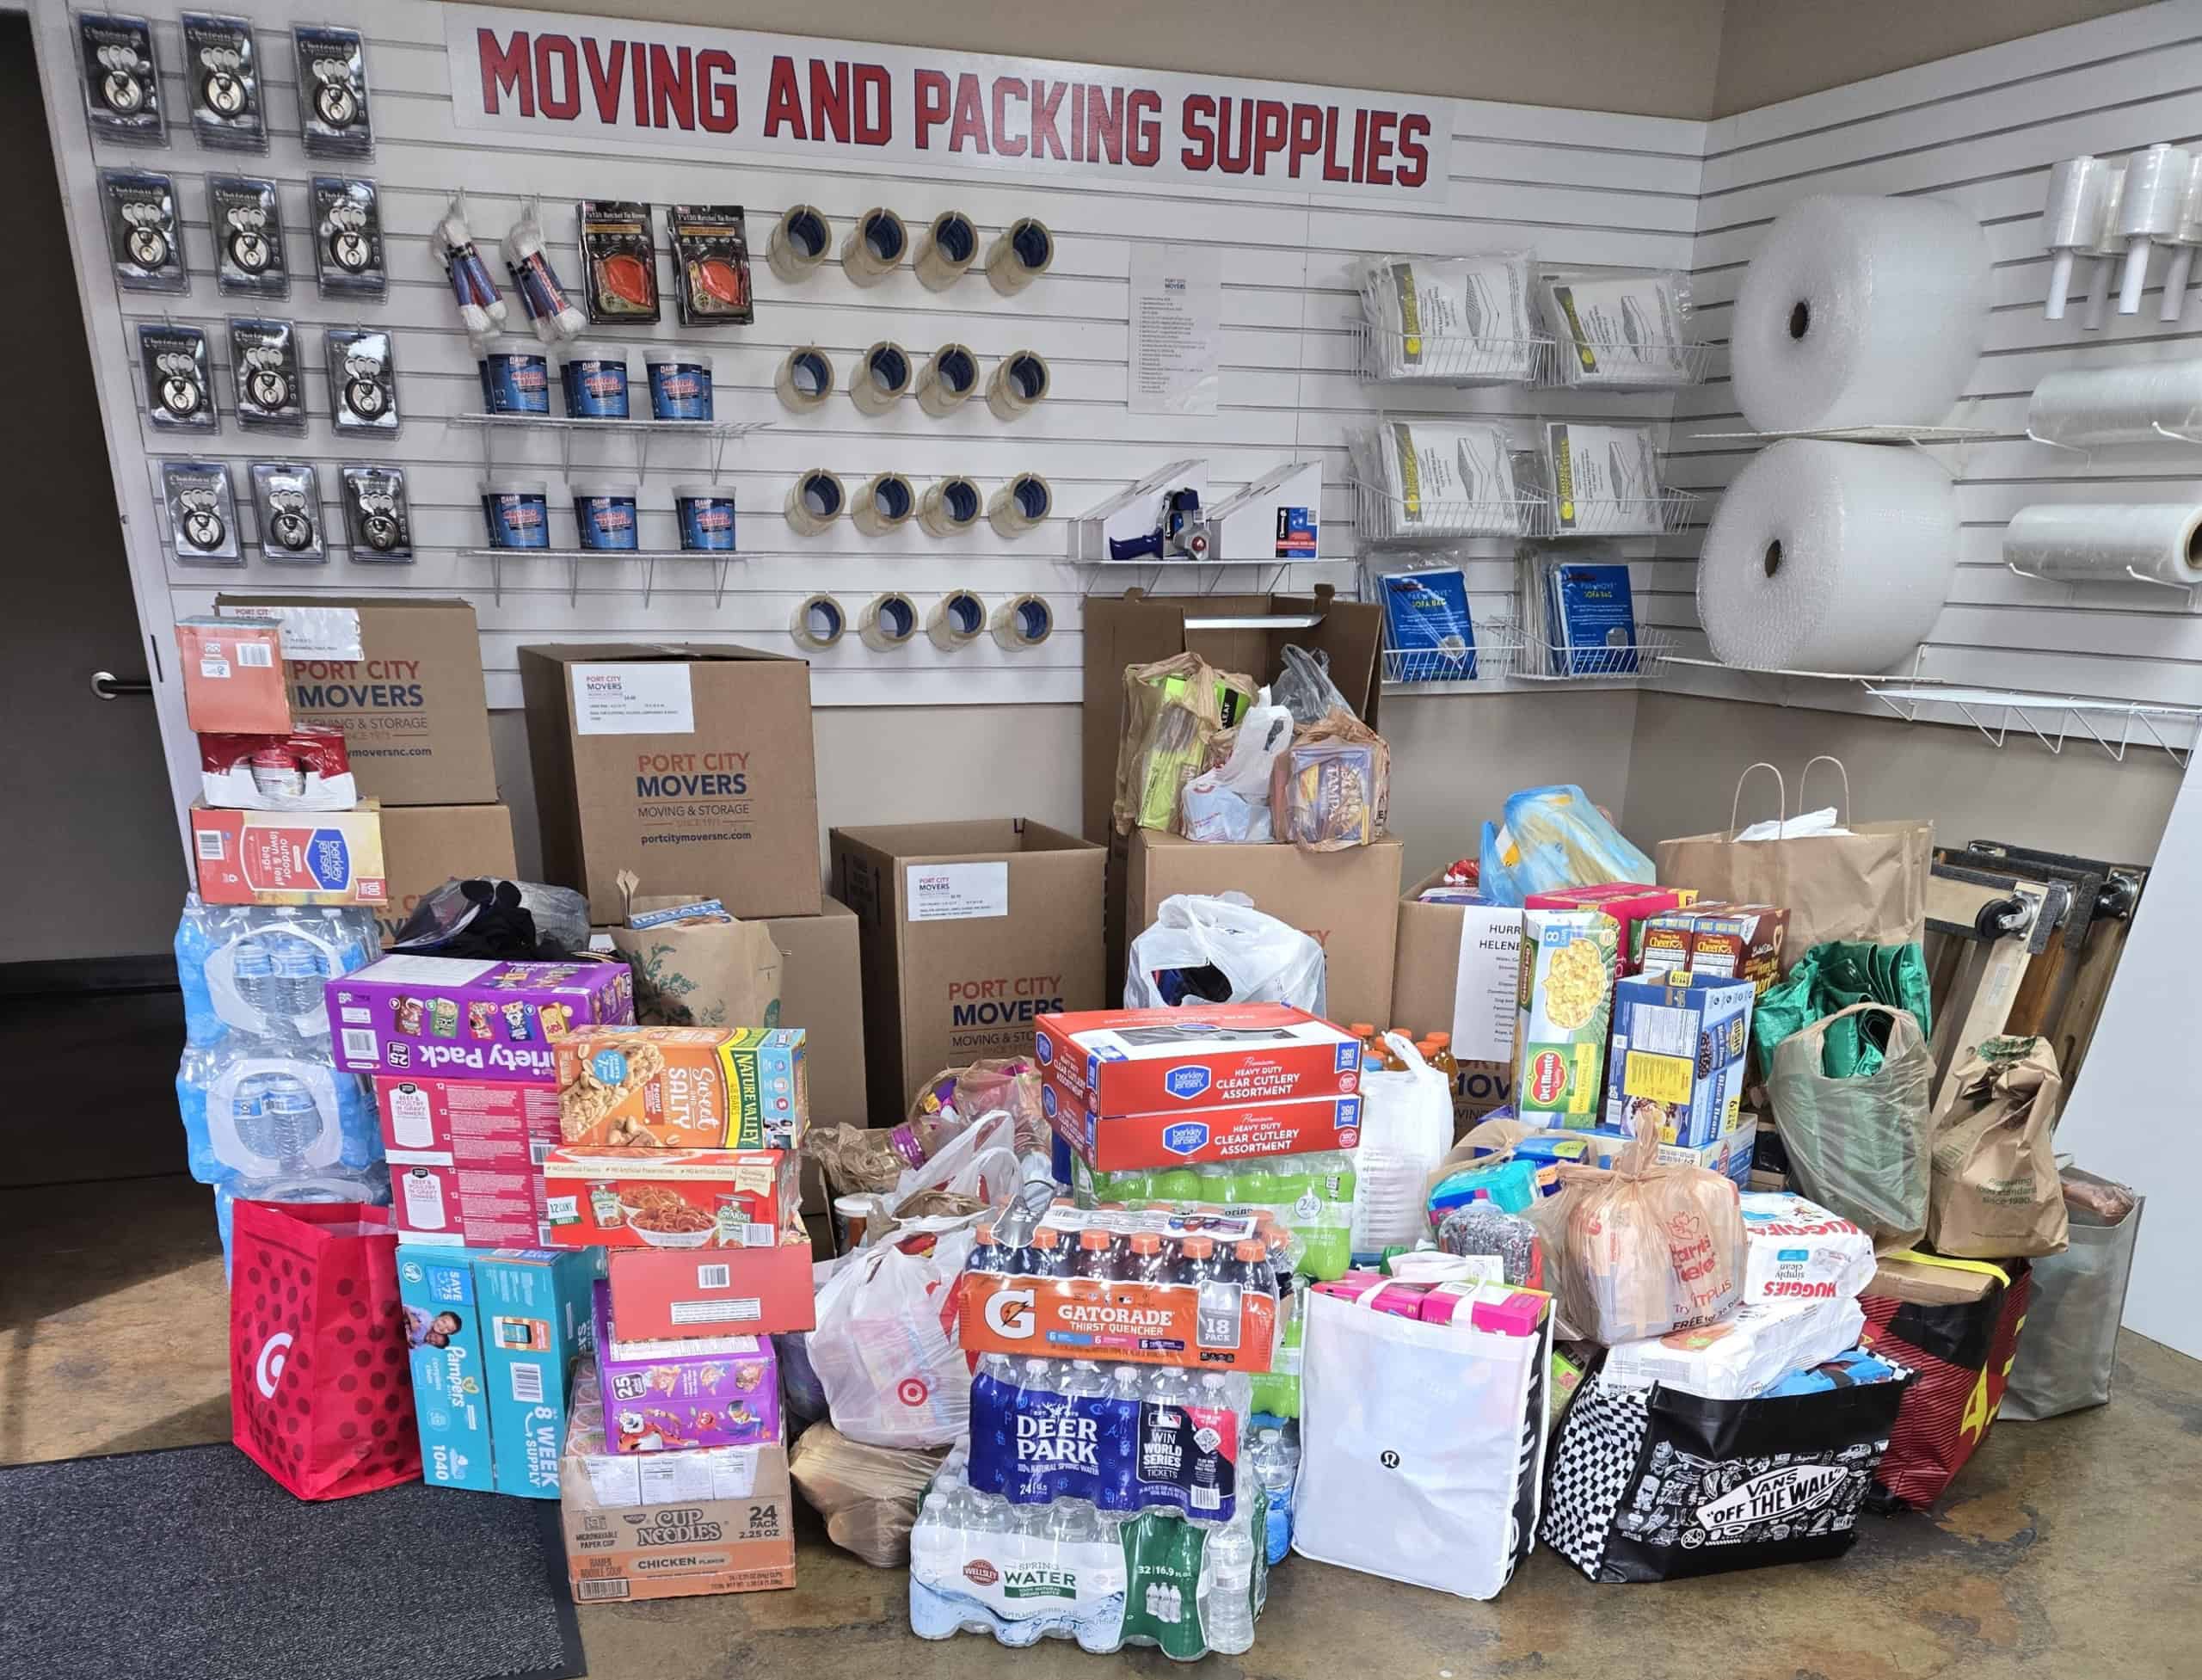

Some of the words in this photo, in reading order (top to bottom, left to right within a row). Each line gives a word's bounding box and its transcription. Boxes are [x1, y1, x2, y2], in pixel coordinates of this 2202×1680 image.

[477, 28, 738, 133] MOVING
[764, 55, 892, 146] AND
[914, 68, 1162, 167] PACKING
[1181, 93, 1430, 188] SUPPLIES
[292, 661, 358, 680] PORT
[366, 661, 420, 680] CITY
[298, 685, 424, 707] MOVERS
[358, 718, 367, 729] &
[372, 717, 427, 729] STORAGE
[348, 748, 432, 758] ymoversnc.com
[638, 754, 695, 772] PORT
[703, 752, 750, 771] CITY
[637, 774, 747, 797] MOVERS
[638, 806, 685, 817] MOVING
[688, 806, 696, 815] &
[698, 804, 749, 815] STORAGE
[641, 831, 751, 846] portcitymoversnc.com
[280, 839, 291, 878] outdoor
[329, 840, 344, 883] berkley
[372, 882, 381, 895] 100
[1490, 925, 1522, 934] HURR
[1546, 932, 1559, 941] 8
[1650, 937, 1683, 949] Cheerios
[1698, 942, 1733, 953] Cheerios
[949, 980, 1007, 1000] PORT
[1015, 975, 1061, 996] CITY
[953, 998, 1064, 1026] MOVERS
[953, 1033, 998, 1047] MOVING
[1003, 1033, 1010, 1043] &
[390, 1053, 408, 1066] 25
[418, 1046, 484, 1068] Pack
[489, 1043, 554, 1070] riety
[1341, 1049, 1354, 1060] 360
[1542, 1053, 1554, 1082] Monte
[735, 1053, 756, 1099] NATURE
[1175, 1072, 1203, 1080] berkley
[1216, 1079, 1250, 1089] CLEAR
[1254, 1074, 1301, 1086] CUTLERY
[667, 1068, 688, 1129] SALTY
[694, 1068, 717, 1131] Sweet
[1222, 1085, 1293, 1099] ASSORTMENT
[1540, 1083, 1550, 1101] Del
[1341, 1105, 1354, 1116] 360
[739, 1100, 760, 1144] VALLEY
[1172, 1128, 1201, 1137] berkley
[1215, 1135, 1249, 1145] CLEAR
[1252, 1129, 1299, 1142] CUTLERY
[1221, 1141, 1291, 1155] ASSORTMENT
[550, 1203, 558, 1213] 12
[450, 1271, 462, 1302] SAVE
[1763, 1281, 1837, 1298] HUGGIES
[985, 1289, 1036, 1339] G
[1058, 1305, 1173, 1327] GATORADE
[1673, 1304, 1691, 1314] Try
[1069, 1320, 1104, 1332] THIRST
[1109, 1323, 1164, 1336] QUENCHER
[1206, 1318, 1229, 1333] 18
[1672, 1314, 1703, 1331] FREE
[1205, 1333, 1231, 1342] PACK
[446, 1345, 465, 1407] Pampers
[615, 1376, 634, 1398] 25
[535, 1406, 552, 1419] 8
[1017, 1415, 1098, 1442] DEER
[1151, 1432, 1176, 1443] WIN
[537, 1426, 558, 1486] WEEK
[1018, 1438, 1099, 1465] PARK
[1143, 1443, 1182, 1456] WORLD
[526, 1439, 540, 1487] SUPPLY
[1031, 1464, 1056, 1474] NATURAL
[1058, 1464, 1079, 1474] SPRING
[1080, 1465, 1100, 1475] WATER
[1142, 1455, 1181, 1468] SERIES
[1147, 1469, 1178, 1480] TICKETS
[1019, 1484, 1030, 1495] 24
[1745, 1473, 1799, 1498] VANS
[1750, 1487, 1787, 1517] THE
[655, 1509, 704, 1527] CUP
[750, 1505, 778, 1521] 24
[637, 1523, 722, 1546] NOODLES
[638, 1557, 696, 1569] CHICKEN
[1019, 1561, 1060, 1571] SPRING
[1137, 1566, 1150, 1574] 32
[1155, 1566, 1174, 1576] 16.9
[1005, 1571, 1075, 1586] WATER
